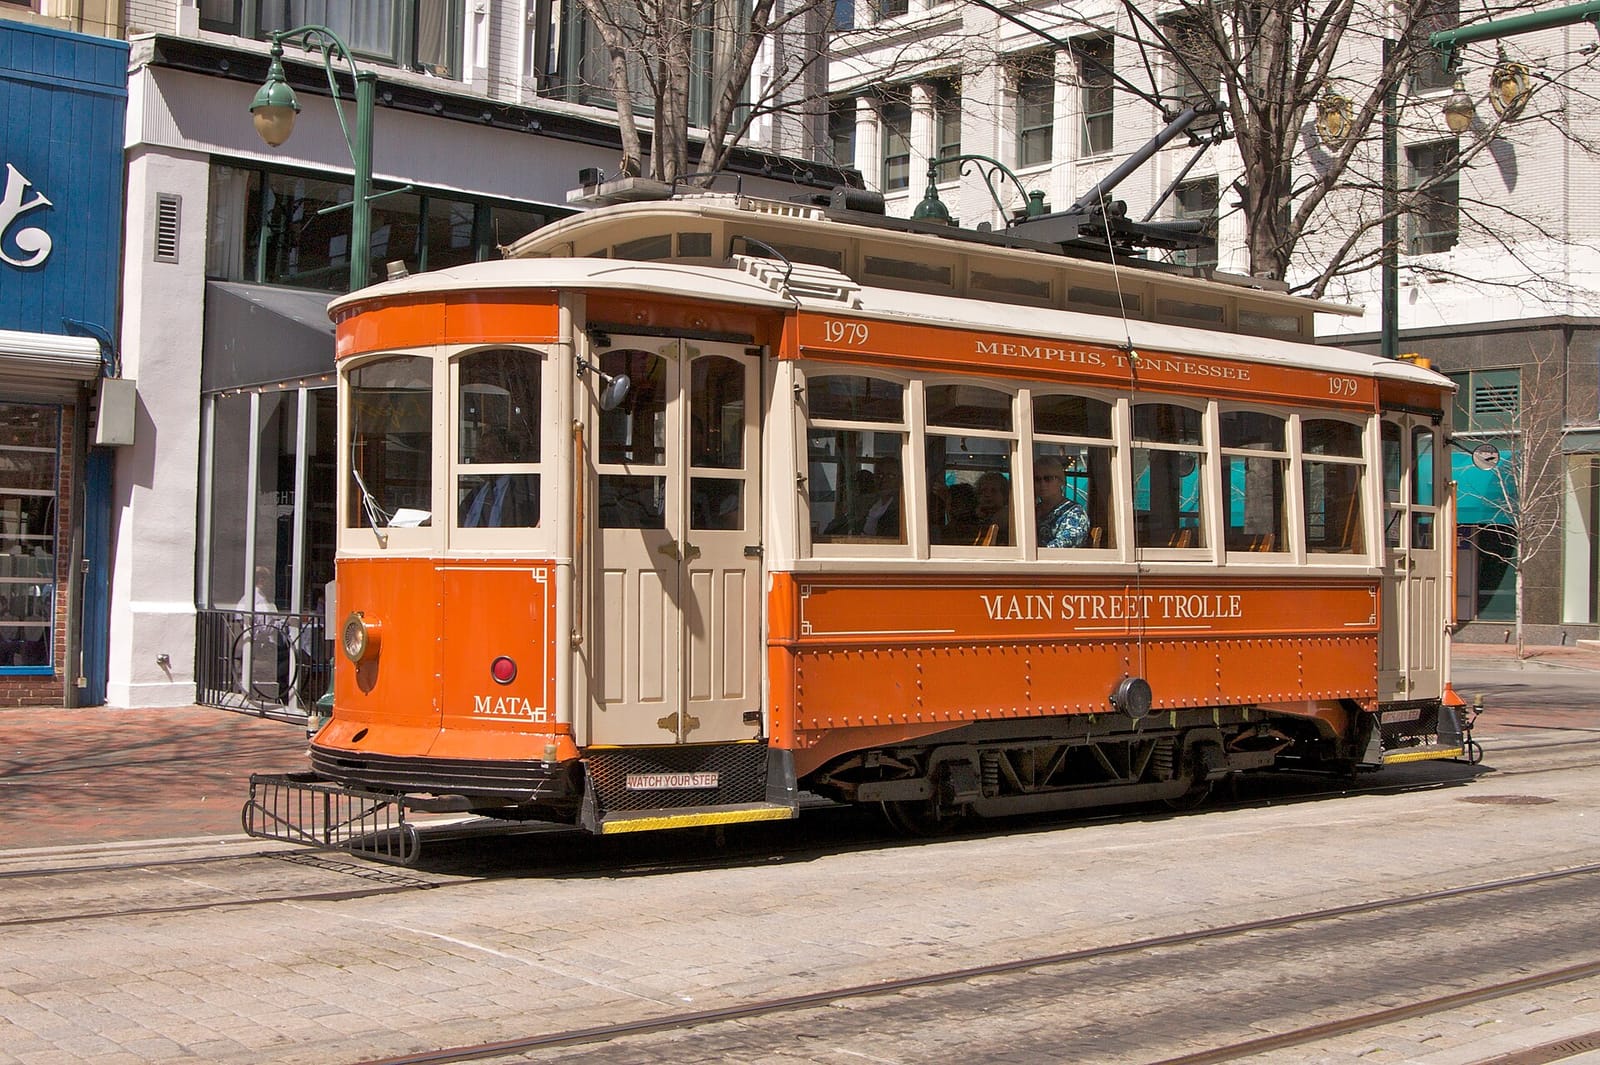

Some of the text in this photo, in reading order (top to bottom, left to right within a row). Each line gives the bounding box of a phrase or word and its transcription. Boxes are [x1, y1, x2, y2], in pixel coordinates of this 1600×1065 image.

[823, 320, 869, 345] 1979
[975, 340, 1251, 381] MEMPHIS, TENNESSEE
[1328, 376, 1358, 397] 1979
[980, 593, 1242, 620] MAIN STREET TROLLE
[473, 695, 533, 716] MATA
[627, 774, 717, 788] WATCH YOUR STEP
